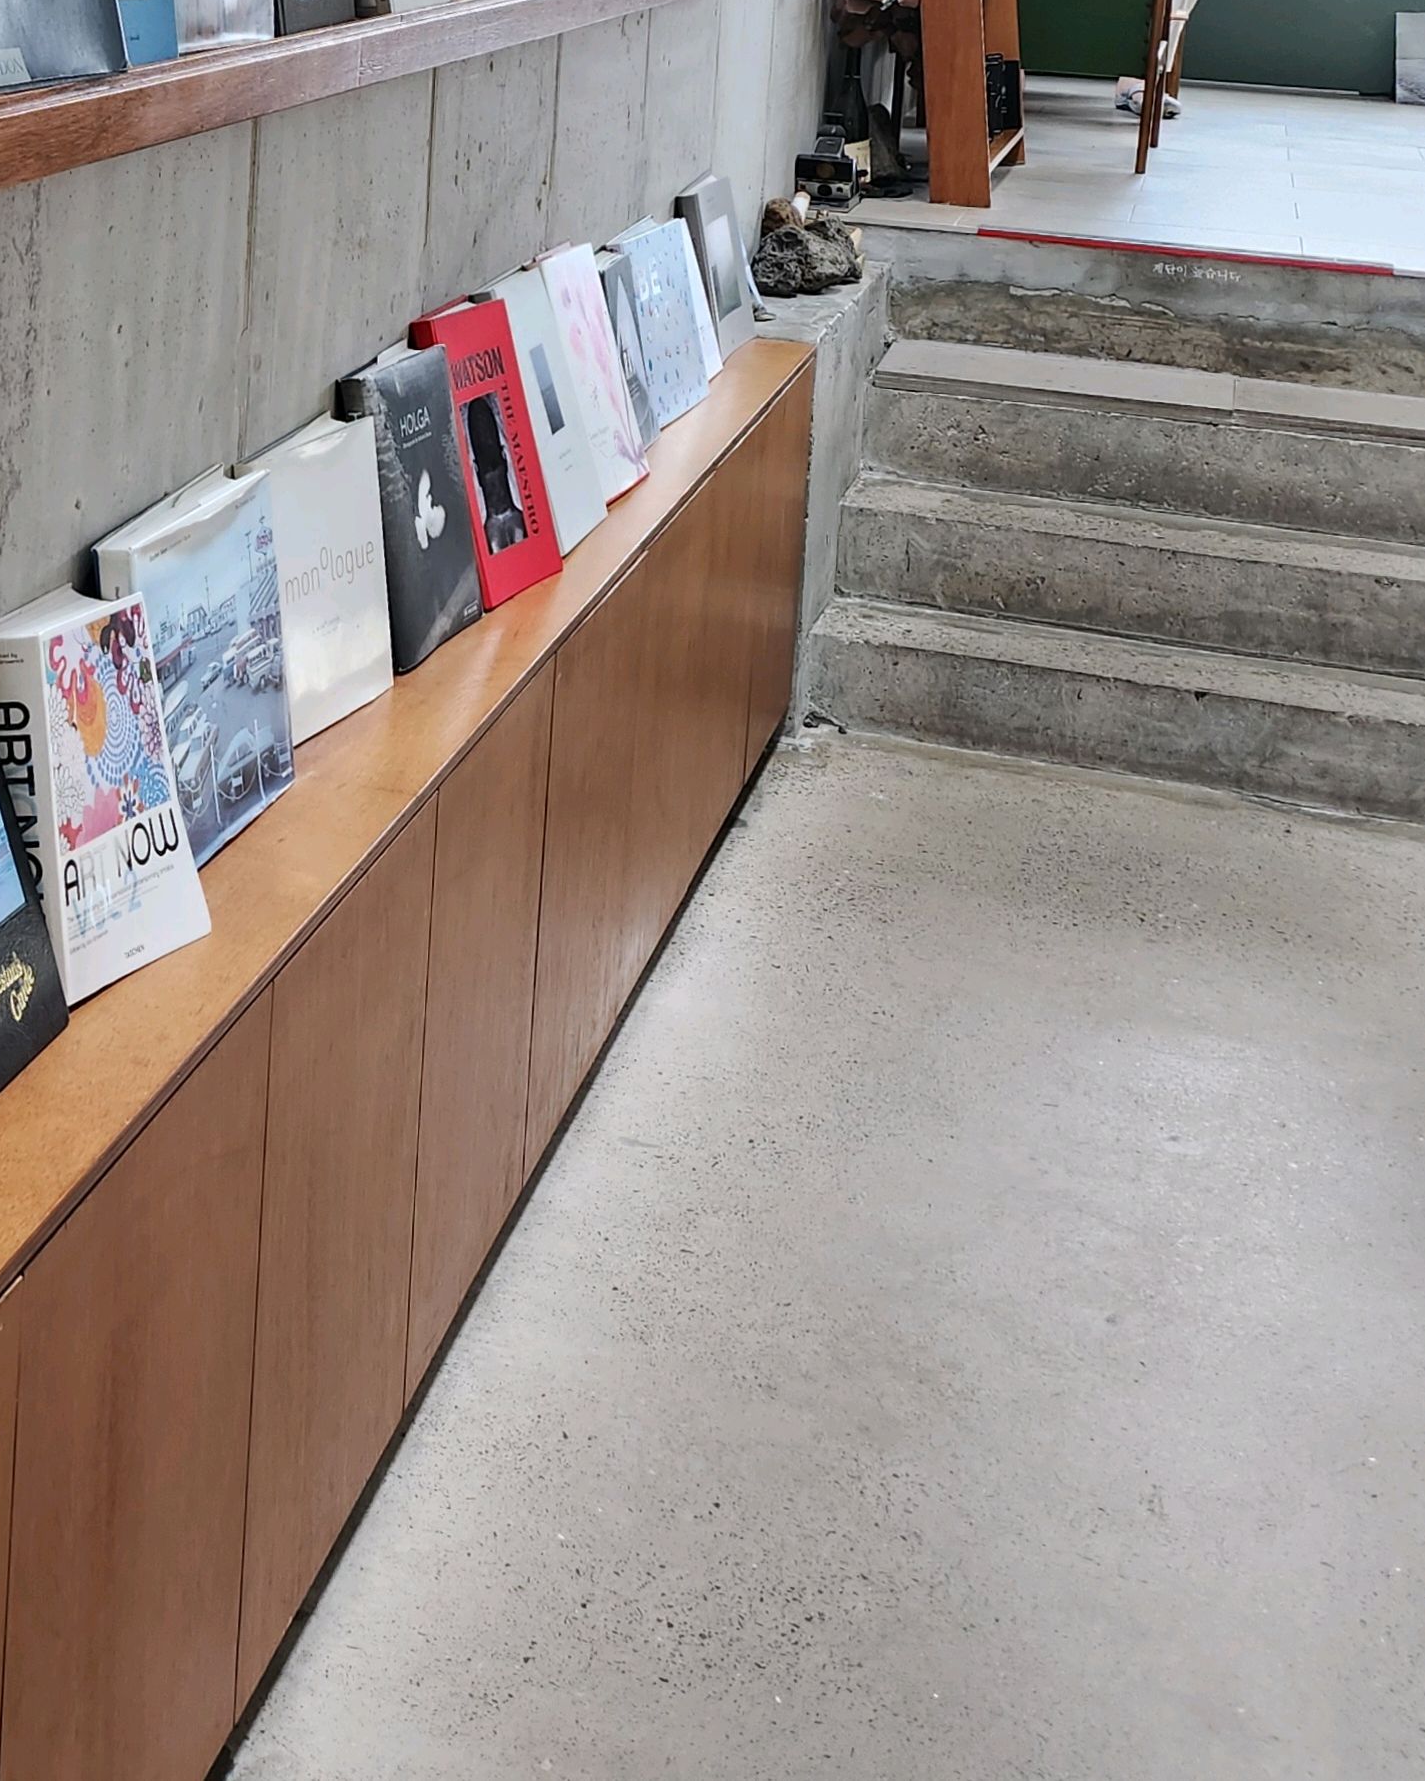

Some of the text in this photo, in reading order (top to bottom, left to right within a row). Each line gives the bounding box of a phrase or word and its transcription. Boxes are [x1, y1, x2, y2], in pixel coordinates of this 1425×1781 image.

[450, 345, 505, 392] WATSON
[399, 406, 432, 438] HOLGA
[64, 843, 108, 907] ART
[114, 807, 179, 878] NOW
